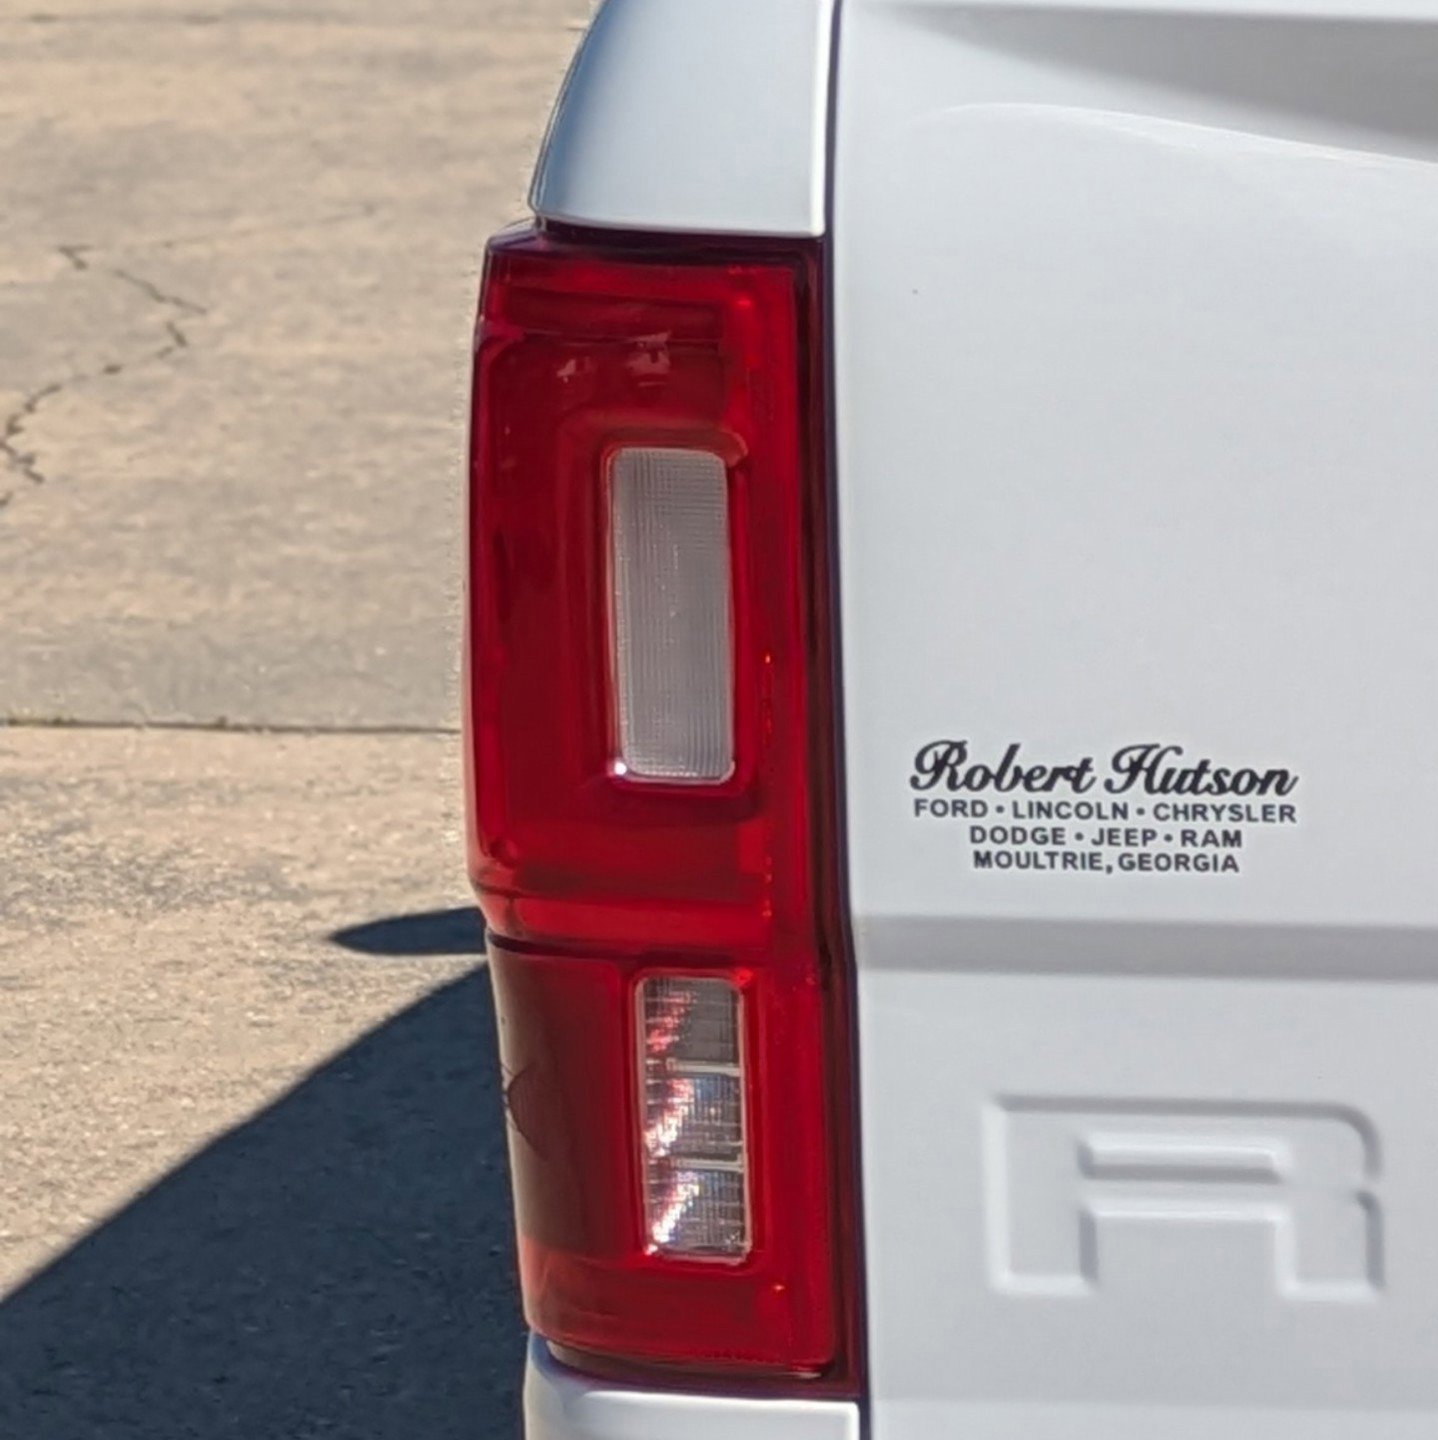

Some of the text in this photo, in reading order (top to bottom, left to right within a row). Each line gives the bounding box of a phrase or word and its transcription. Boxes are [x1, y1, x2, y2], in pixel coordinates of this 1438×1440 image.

[909, 739, 1299, 796] Robert Hutson
[913, 798, 1298, 823] FORD LINCOLN CHRYSLER
[969, 826, 1243, 848] DODGE JEEP RAM
[973, 850, 1240, 874] MOULTRIE, GEORGIA
